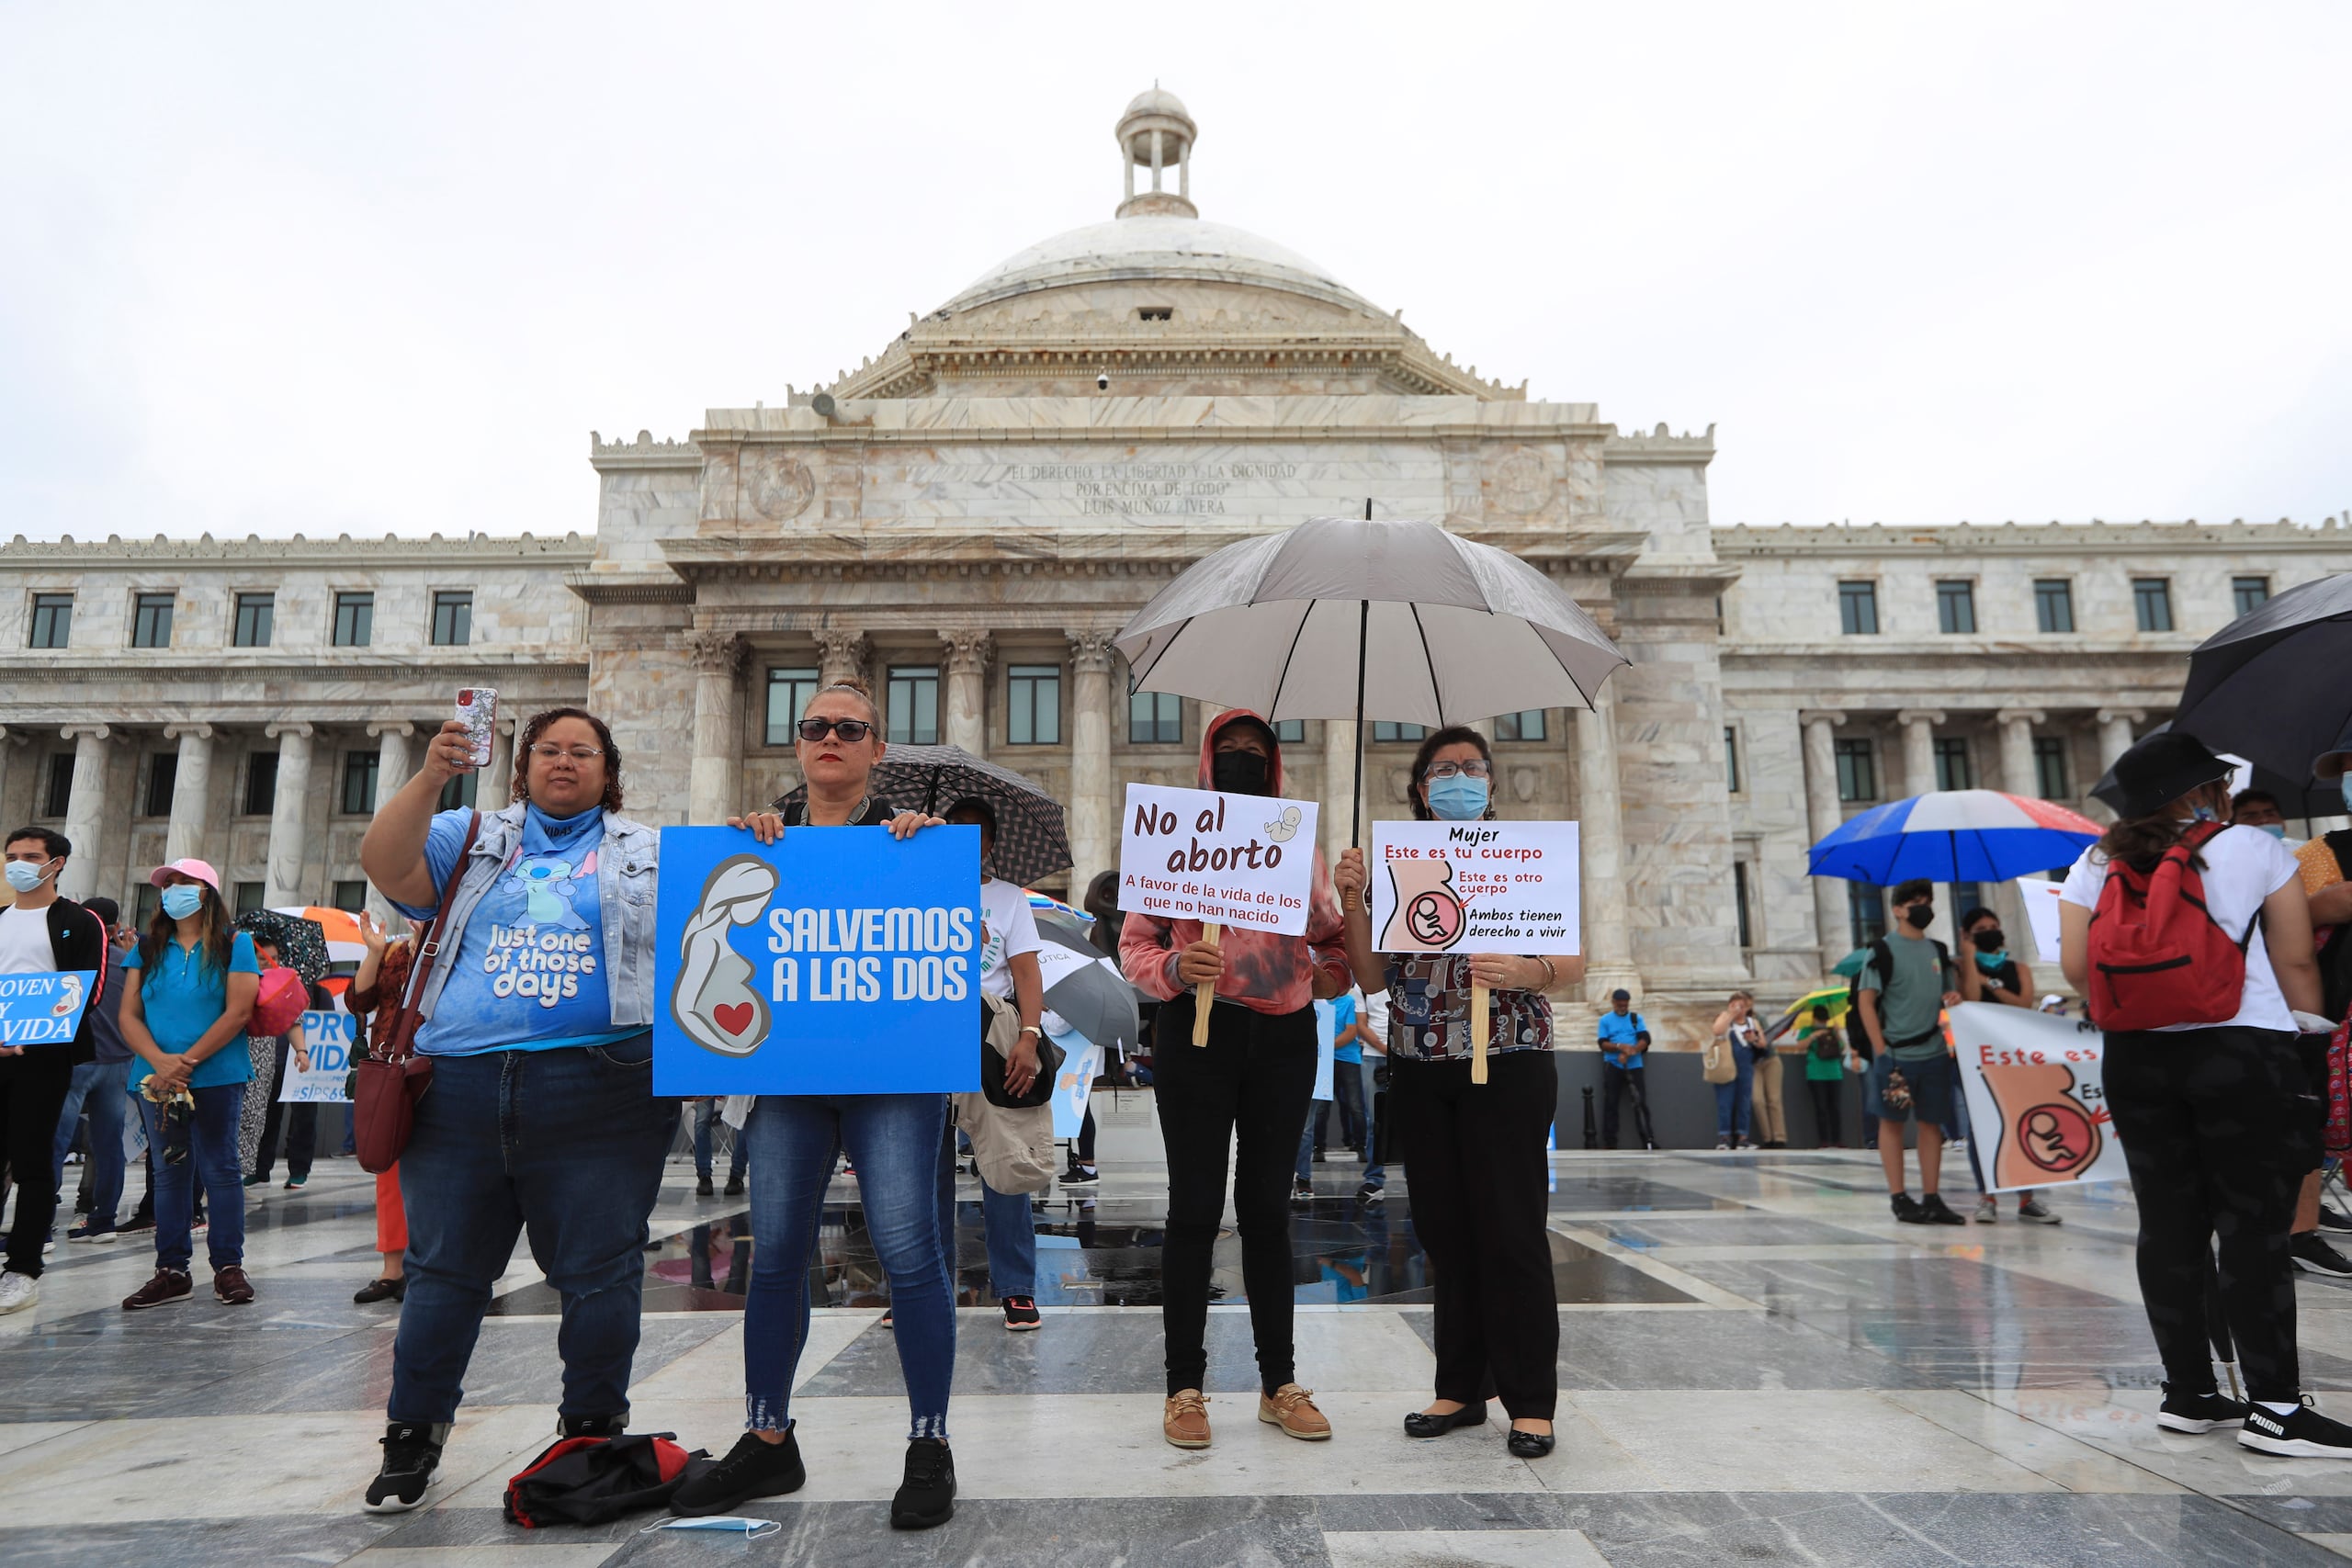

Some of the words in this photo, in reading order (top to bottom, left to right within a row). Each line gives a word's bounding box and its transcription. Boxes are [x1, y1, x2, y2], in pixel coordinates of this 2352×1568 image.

[1102, 465, 1118, 479] LA
[1124, 465, 1186, 479] LIBERTAD
[1208, 465, 1225, 478] LA
[1232, 464, 1296, 479] DIGNIDAD
[1076, 482, 1101, 496] POR
[1105, 482, 1158, 496] ENCIMA
[1165, 482, 1182, 496] DE
[1084, 500, 1114, 514] LUIS
[1122, 497, 1170, 514] MUÑOZ
[1177, 499, 1226, 513] RIVERA
[1134, 803, 1178, 837] No
[1196, 796, 1226, 833] al
[1449, 827, 1499, 847] Mujer
[1167, 837, 1283, 873] aborto
[1385, 844, 1419, 859] Este
[1429, 848, 1446, 859] es
[1454, 846, 1472, 859] tu
[1481, 847, 1543, 863] cuerpo
[1459, 871, 1487, 883] Este
[1494, 874, 1508, 883] es
[1515, 873, 1543, 883] otro
[1125, 874, 1136, 887] A
[1140, 875, 1179, 892] favor
[1182, 882, 1199, 896] de
[1203, 884, 1216, 897] la
[1220, 886, 1251, 903] vida
[1256, 891, 1274, 905] de
[1279, 894, 1302, 909] los
[1459, 884, 1508, 896] cuerpo
[1144, 897, 1170, 910] que
[1175, 900, 1193, 912] no
[1198, 901, 1224, 916] han
[1229, 907, 1280, 925] nacido
[1469, 908, 1514, 921] Ambos
[1520, 909, 1562, 921] tienen
[486, 924, 537, 957] Just
[541, 933, 592, 953] one
[767, 907, 973, 953] SALVEMOS
[1469, 924, 1521, 937] derecho
[1526, 928, 1533, 937] a
[1540, 926, 1566, 938] vivir
[484, 948, 513, 974] of
[518, 948, 597, 976] those
[0, 978, 56, 998] OVEN
[493, 966, 579, 1009] days
[773, 957, 798, 1002] A
[810, 956, 881, 1002] LAS
[893, 956, 967, 1002] DOS
[3, 1018, 72, 1042] VIDA
[1979, 1045, 2045, 1065] Este
[2065, 1049, 2097, 1062] es
[2249, 1412, 2285, 1436] PUMA
